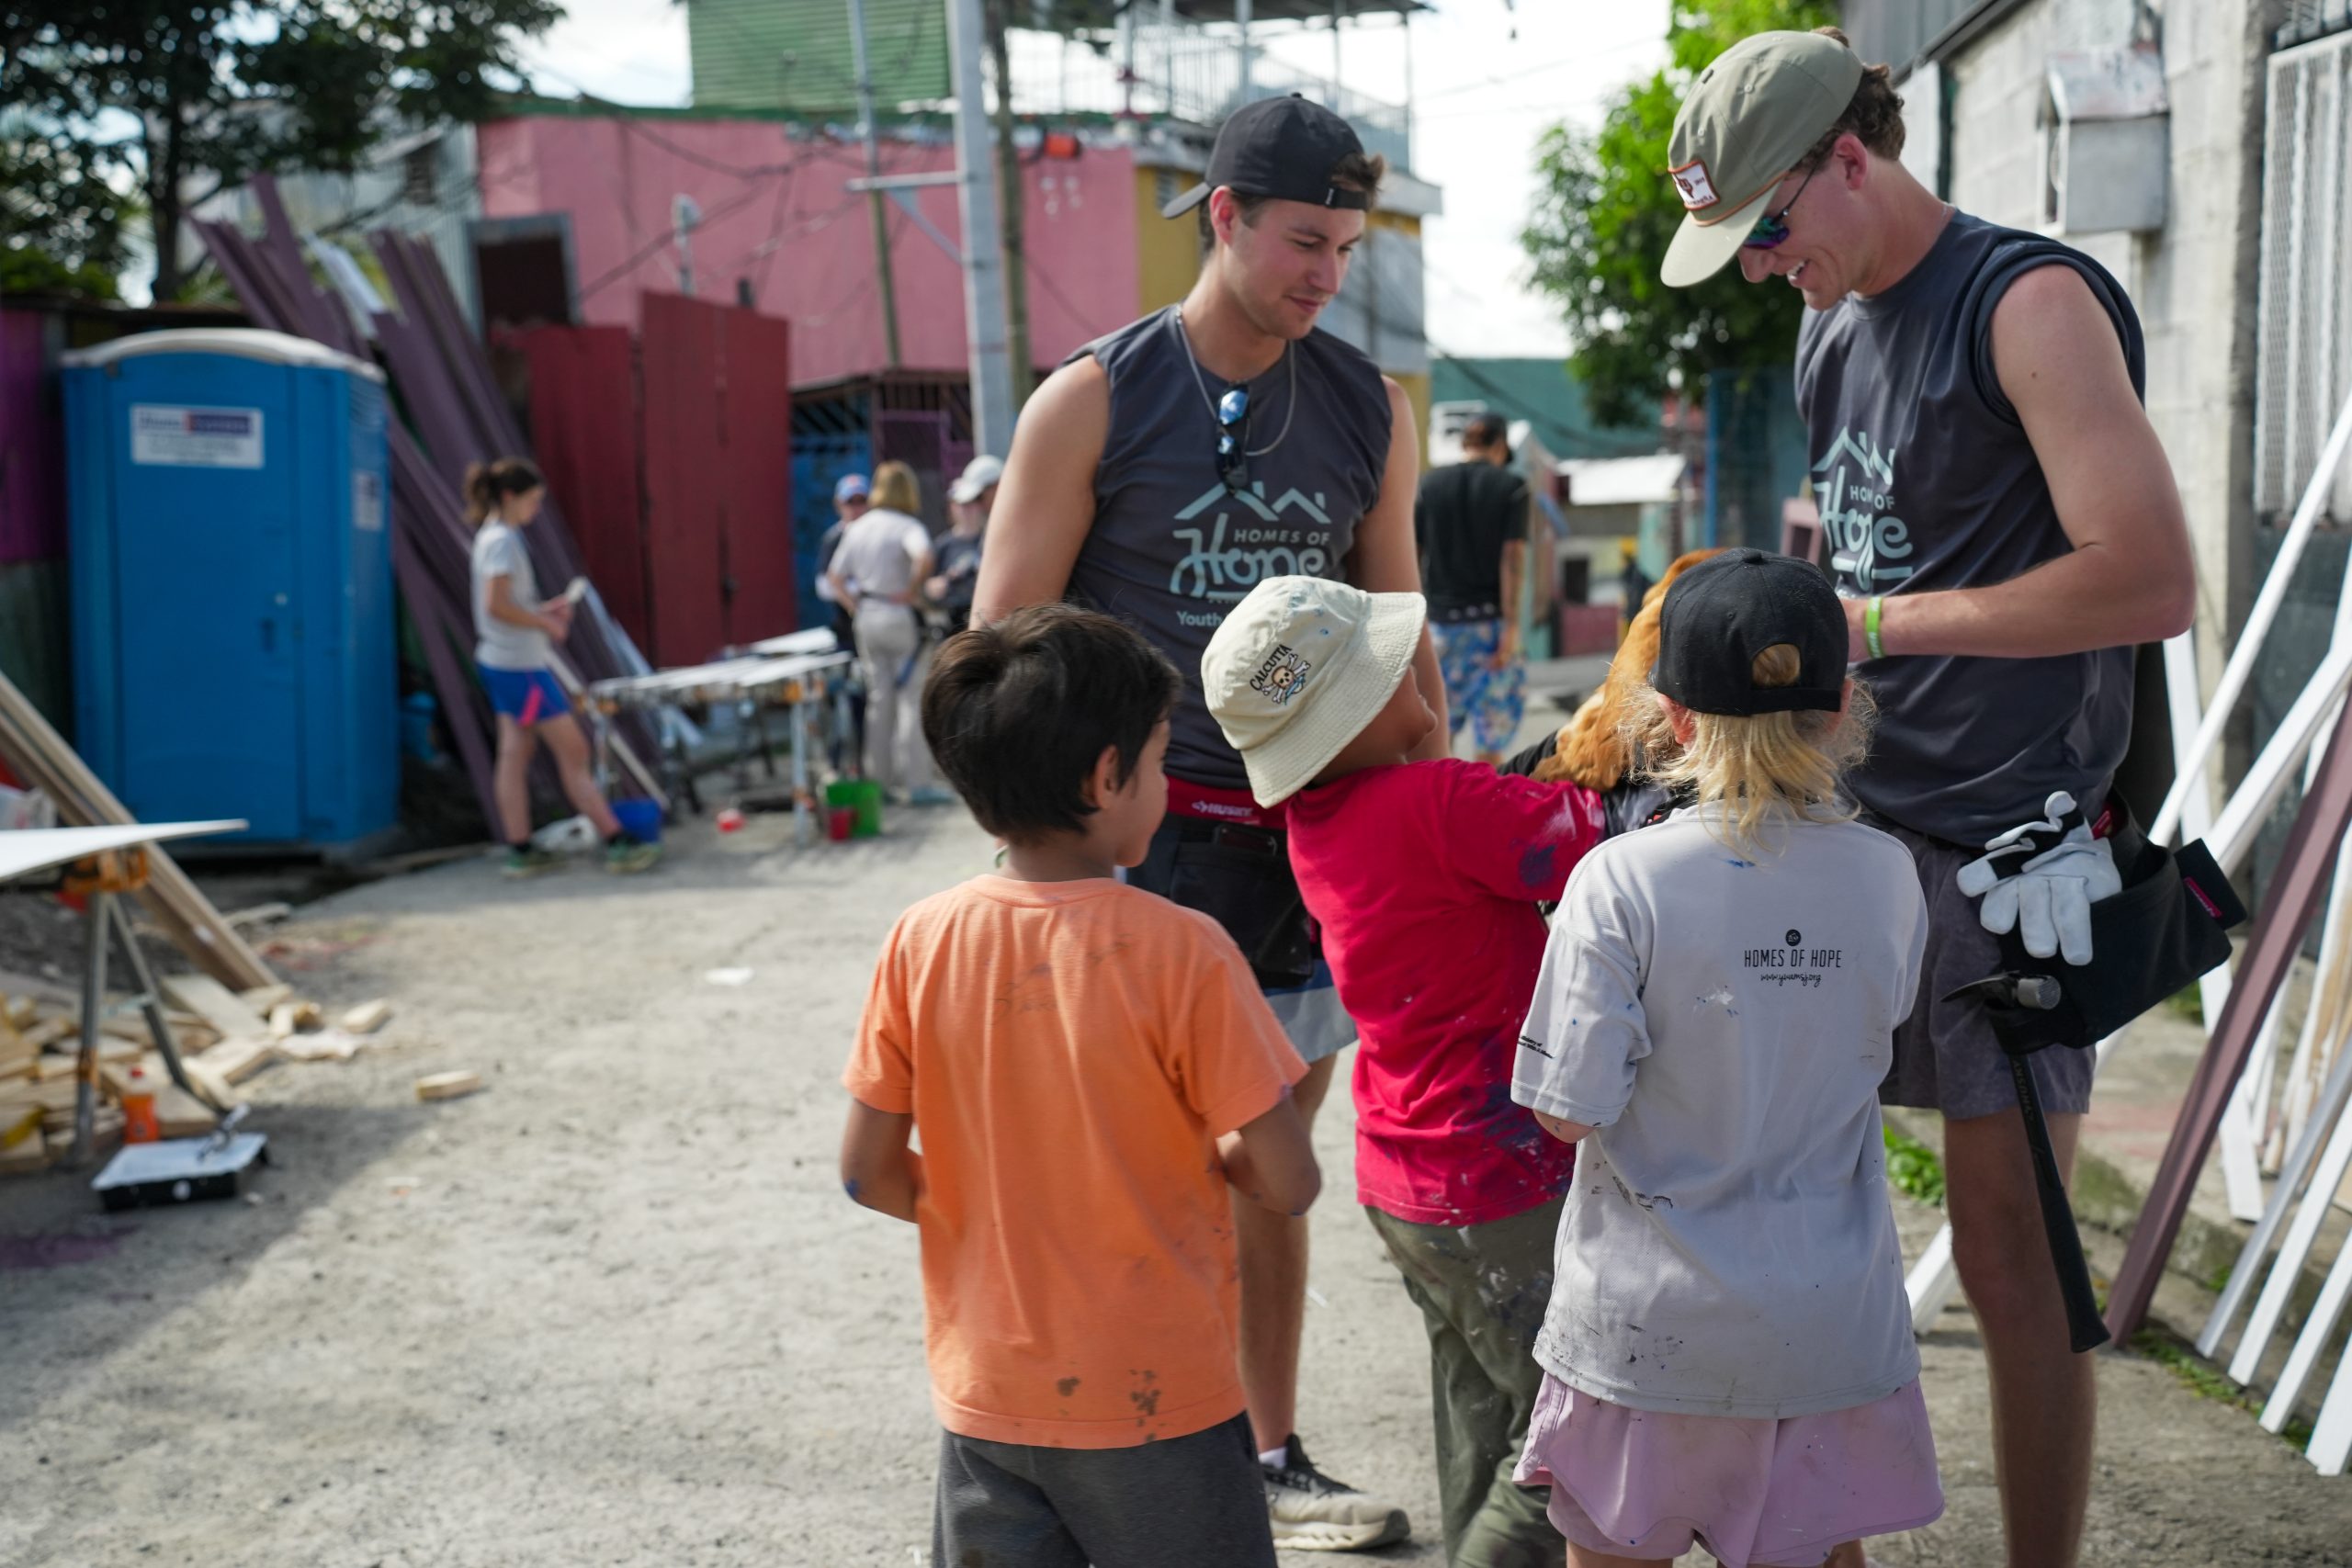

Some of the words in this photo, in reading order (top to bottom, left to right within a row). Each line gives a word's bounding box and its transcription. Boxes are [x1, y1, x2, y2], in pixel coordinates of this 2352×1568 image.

[1874, 494, 1894, 510] OF
[1234, 528, 1301, 544] HOMES
[1306, 532, 1330, 546] OF
[1177, 611, 1223, 626] Youth
[1250, 643, 1293, 691] CALCUTTA
[1744, 949, 1785, 968] HOMES
[1791, 949, 1804, 967] OF
[1810, 950, 1842, 968] HOPE
